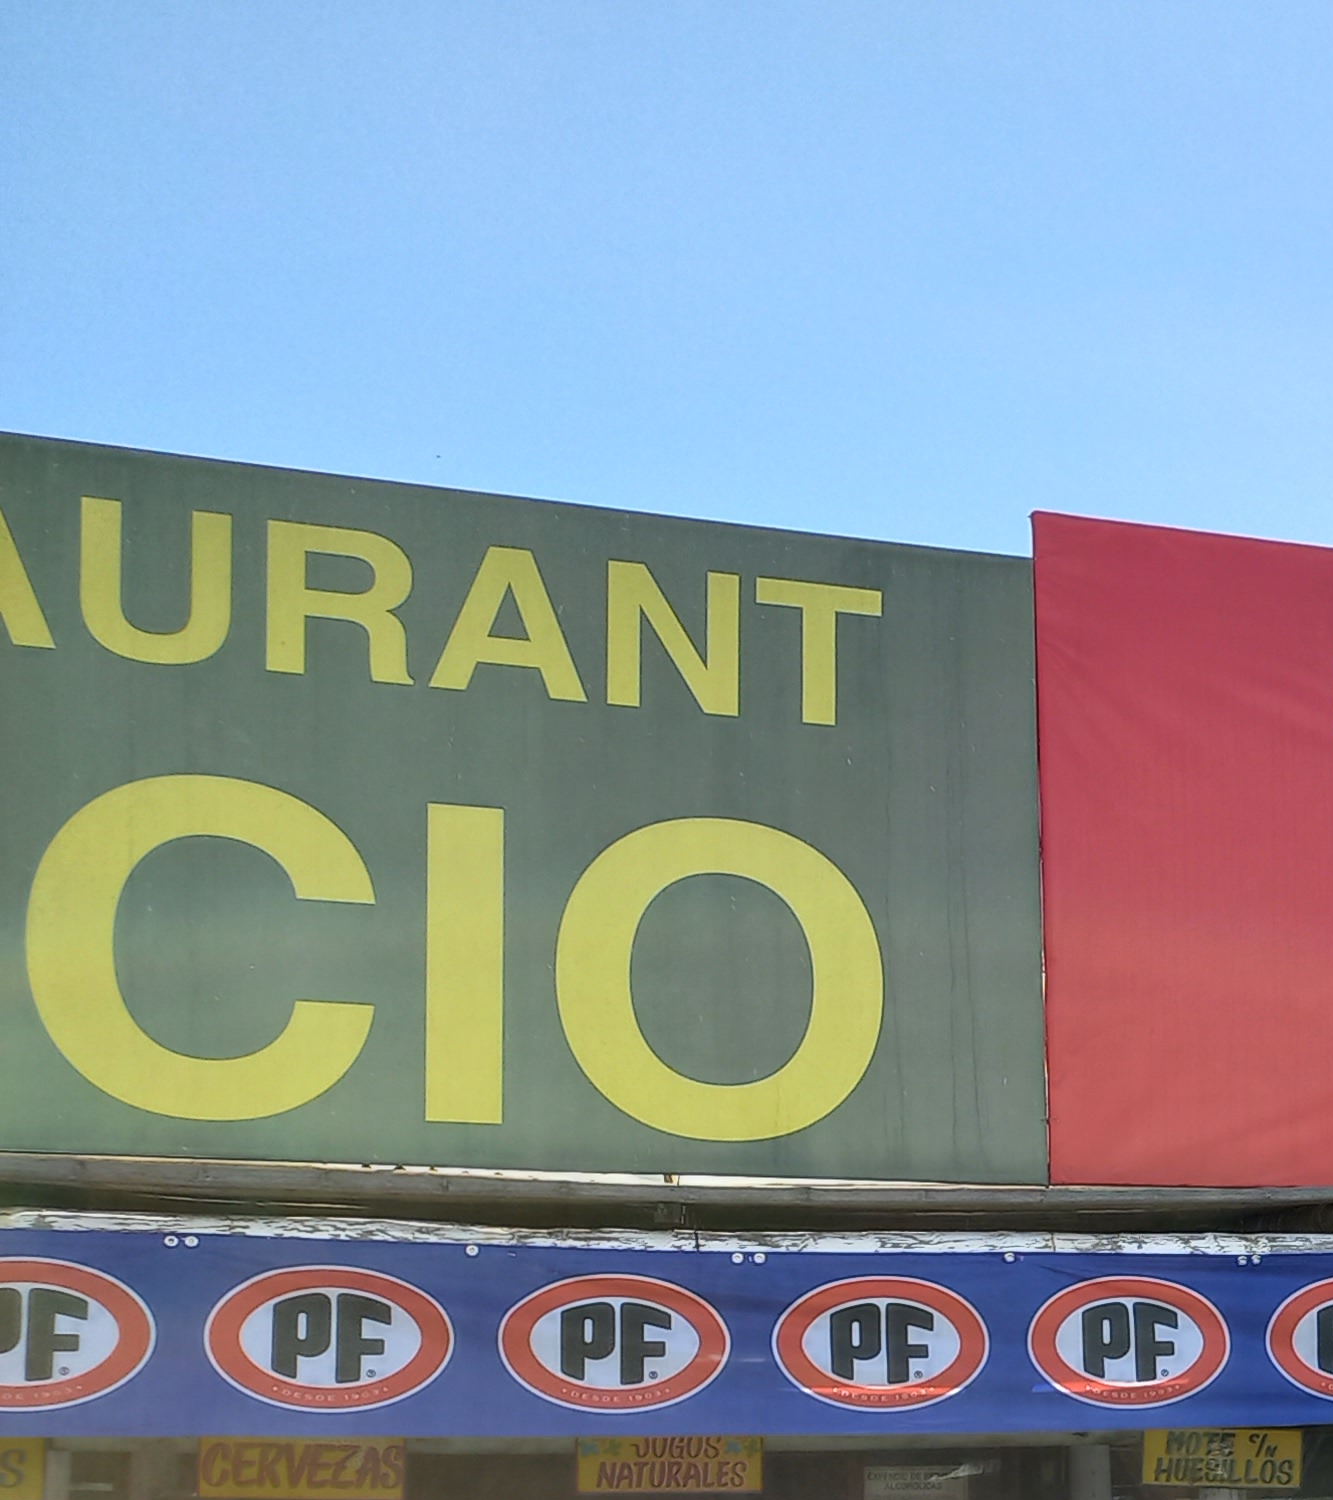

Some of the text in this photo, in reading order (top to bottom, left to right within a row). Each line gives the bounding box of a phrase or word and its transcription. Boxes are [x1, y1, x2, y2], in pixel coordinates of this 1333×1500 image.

[25, 773, 884, 1142] CIO
[271, 1292, 392, 1384] PF
[560, 1301, 672, 1385] PF
[829, 1303, 934, 1384] PF
[1081, 1301, 1179, 1382] PF
[201, 1442, 402, 1491] CERVEZAS
[596, 1460, 748, 1489] NATURALES
[1153, 1457, 1294, 1485] HUESILLOS
